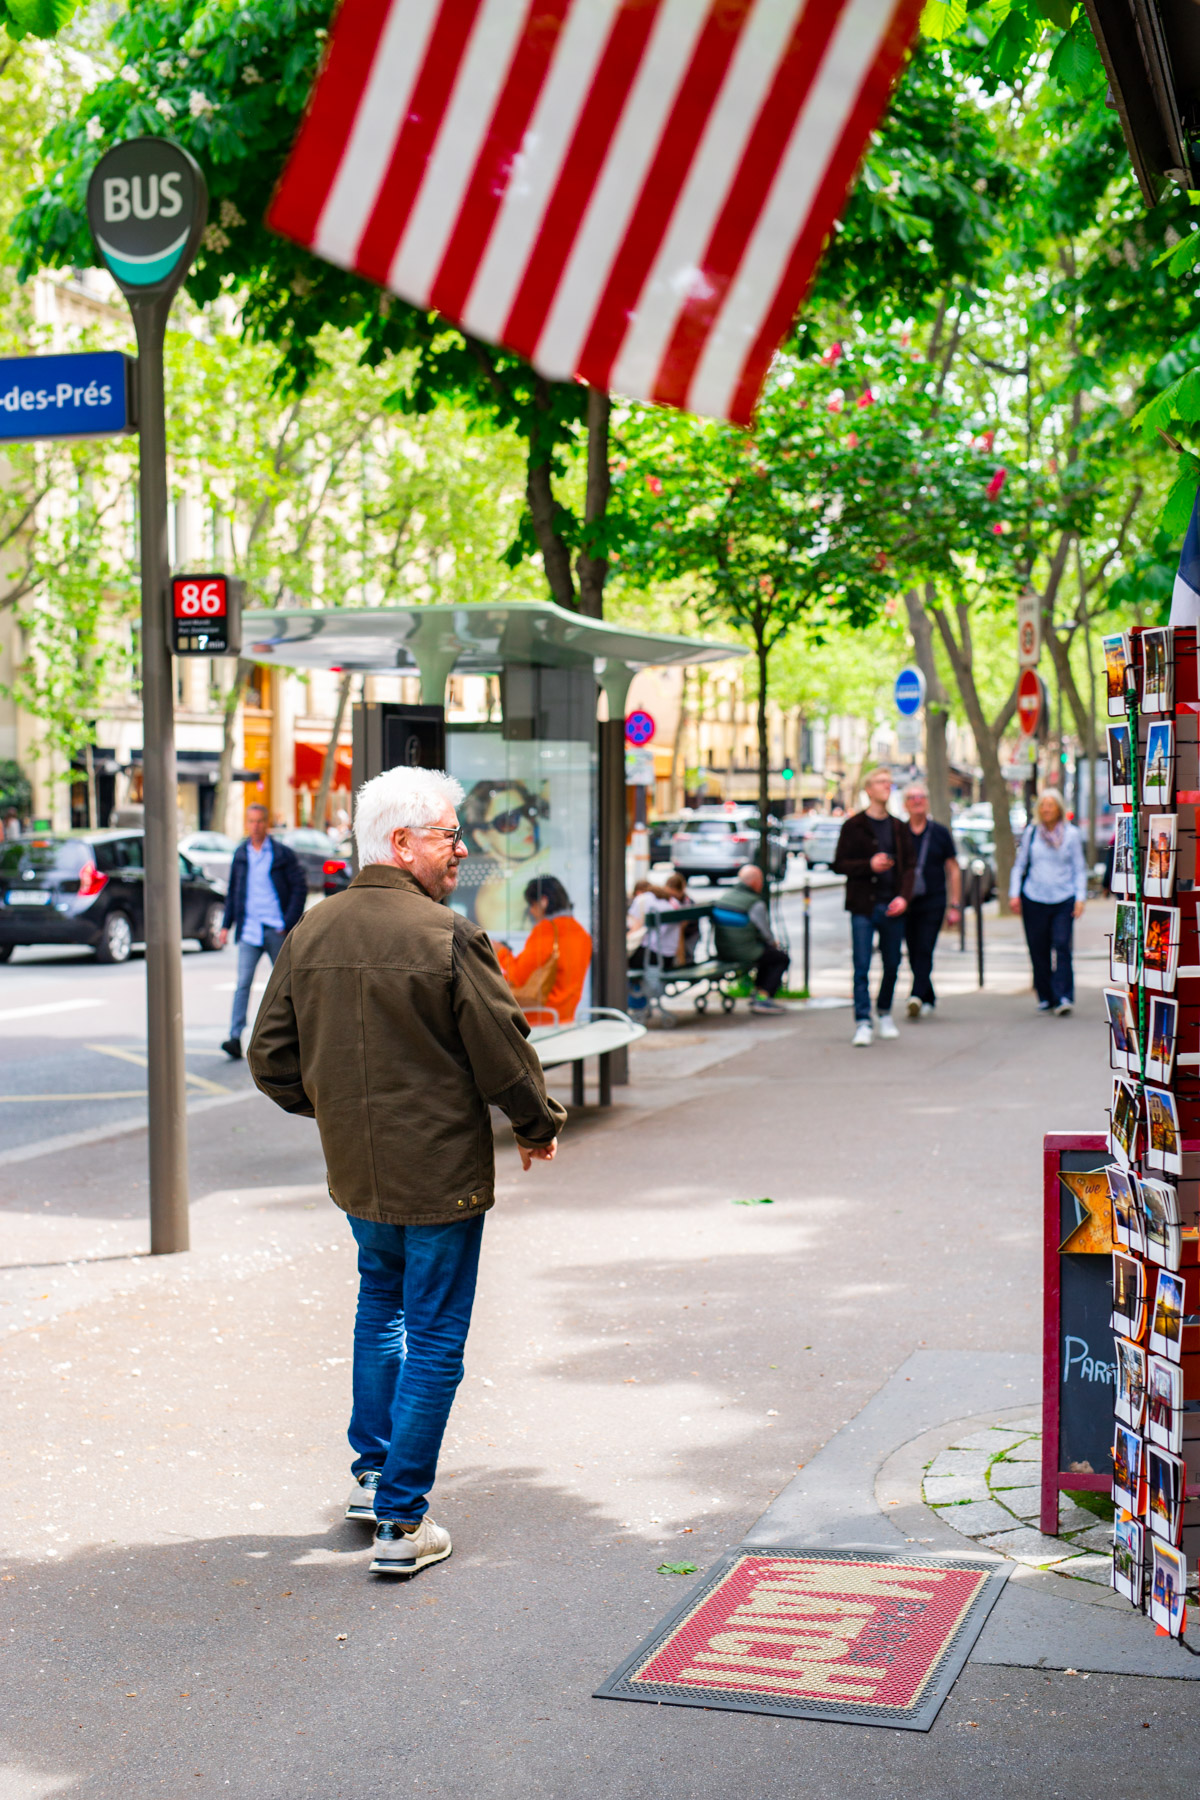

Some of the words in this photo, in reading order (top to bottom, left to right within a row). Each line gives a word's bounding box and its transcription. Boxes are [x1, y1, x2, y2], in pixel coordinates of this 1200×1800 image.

[104, 171, 183, 222] BUS
[181, 583, 221, 615] 86
[198, 634, 209, 650] 7
[1085, 1184, 1102, 1195] we
[678, 1561, 947, 1698] MATCH
[848, 1600, 928, 1664] PARIS
